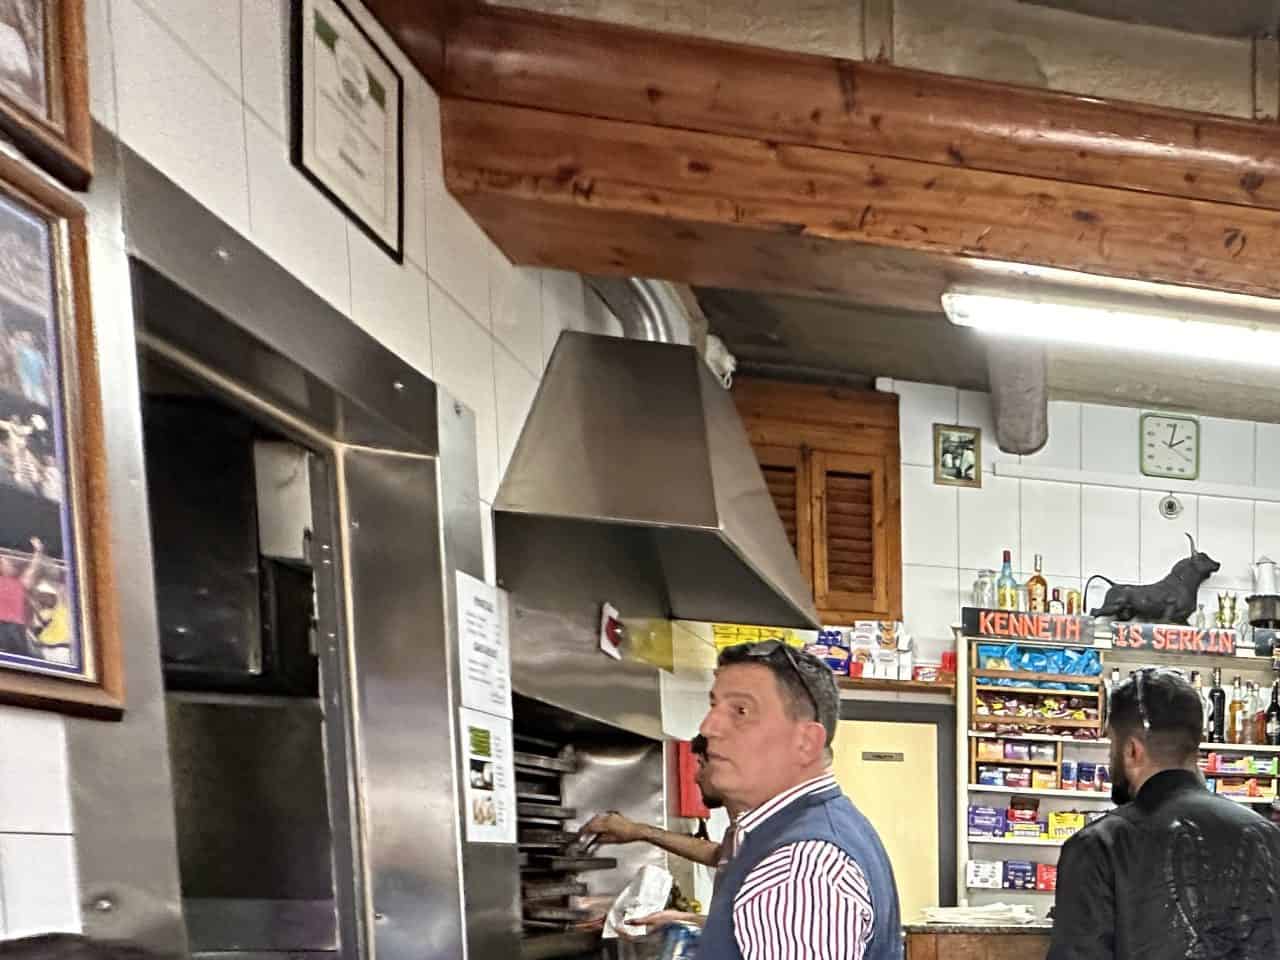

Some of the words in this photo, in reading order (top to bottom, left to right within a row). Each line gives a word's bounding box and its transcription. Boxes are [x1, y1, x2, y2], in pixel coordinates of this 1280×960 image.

[979, 611, 1081, 640] KENNETH
[1115, 623, 1145, 647] IS
[1152, 627, 1234, 653] SERKIN
